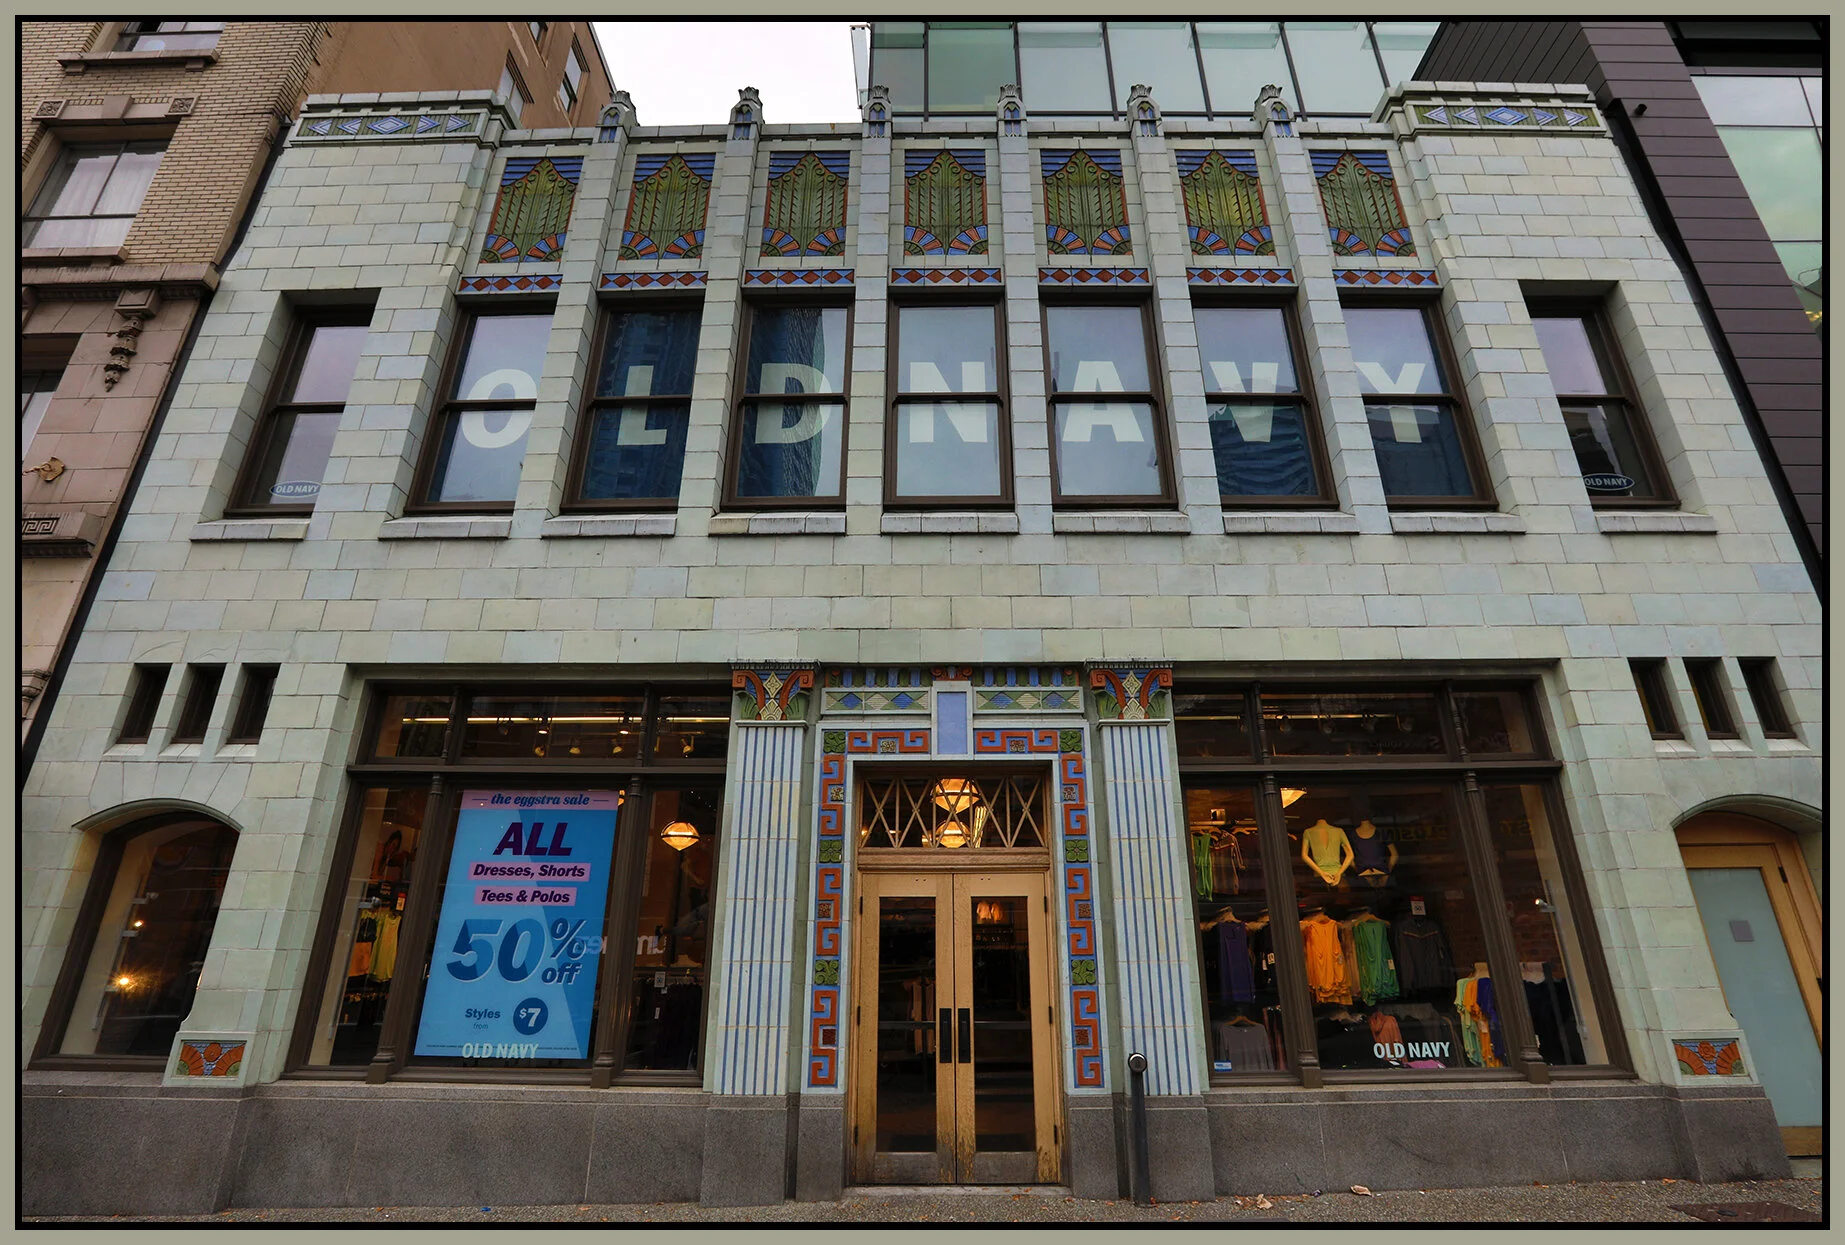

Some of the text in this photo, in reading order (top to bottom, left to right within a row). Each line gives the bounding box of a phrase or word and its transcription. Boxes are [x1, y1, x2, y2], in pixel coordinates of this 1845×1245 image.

[461, 361, 1426, 448] OLD NAVY
[275, 485, 320, 494] OLD NAVY
[1584, 478, 1628, 486] OLD NAVY
[491, 793, 590, 807] the eggstra sale
[492, 821, 573, 856] ALL
[473, 863, 585, 879] Dresses, Shorts
[481, 889, 570, 903] Tees & Polos
[446, 918, 587, 983] 50%
[541, 962, 582, 985] off
[464, 1008, 501, 1020] Styles
[519, 1007, 542, 1027] $7
[461, 1042, 493, 1059] OLD
[495, 1042, 539, 1059] NAVY
[1373, 1041, 1450, 1059] OLD NAVY
